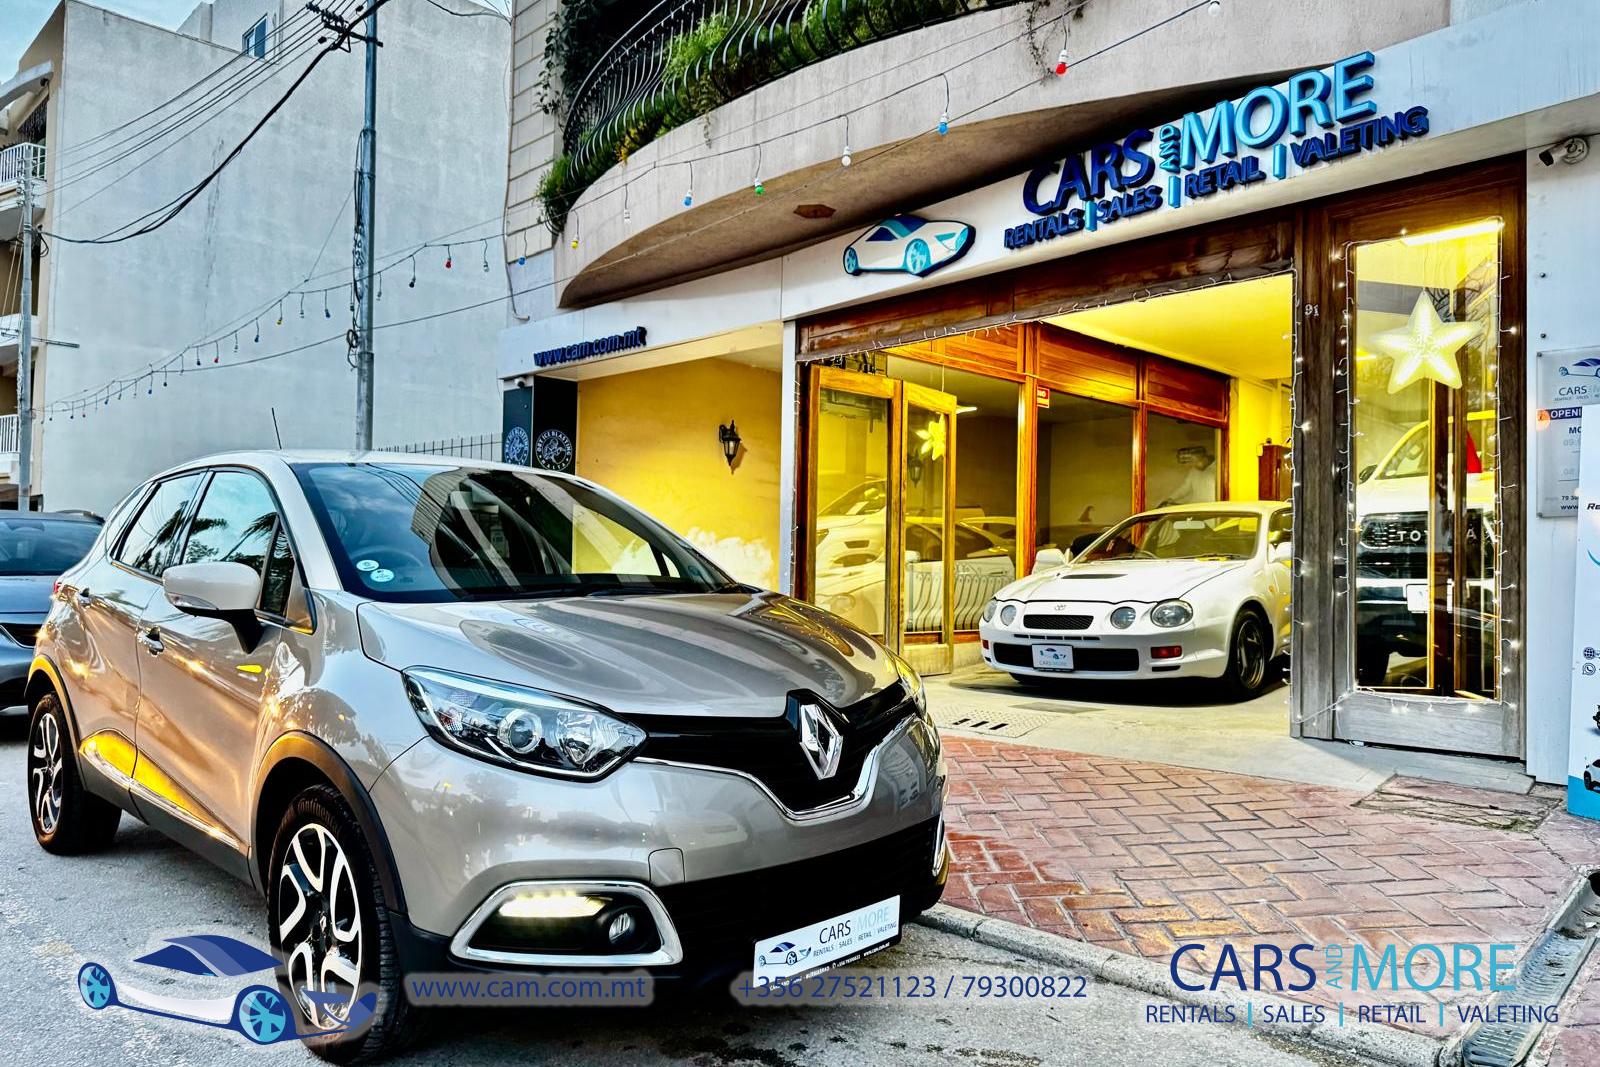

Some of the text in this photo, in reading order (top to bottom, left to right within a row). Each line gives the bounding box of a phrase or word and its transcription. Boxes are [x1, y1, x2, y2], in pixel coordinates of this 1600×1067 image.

[1023, 51, 1377, 216] CARS AND MORE
[1004, 105, 1430, 250] RENTALS SALES RETAIL VALETING
[533, 326, 648, 367] www.cam.com.mt
[1558, 385, 1588, 396] CARS
[813, 920, 897, 957] RENTALS SALES RETAIL VALETING
[820, 906, 889, 944] CARS MORE
